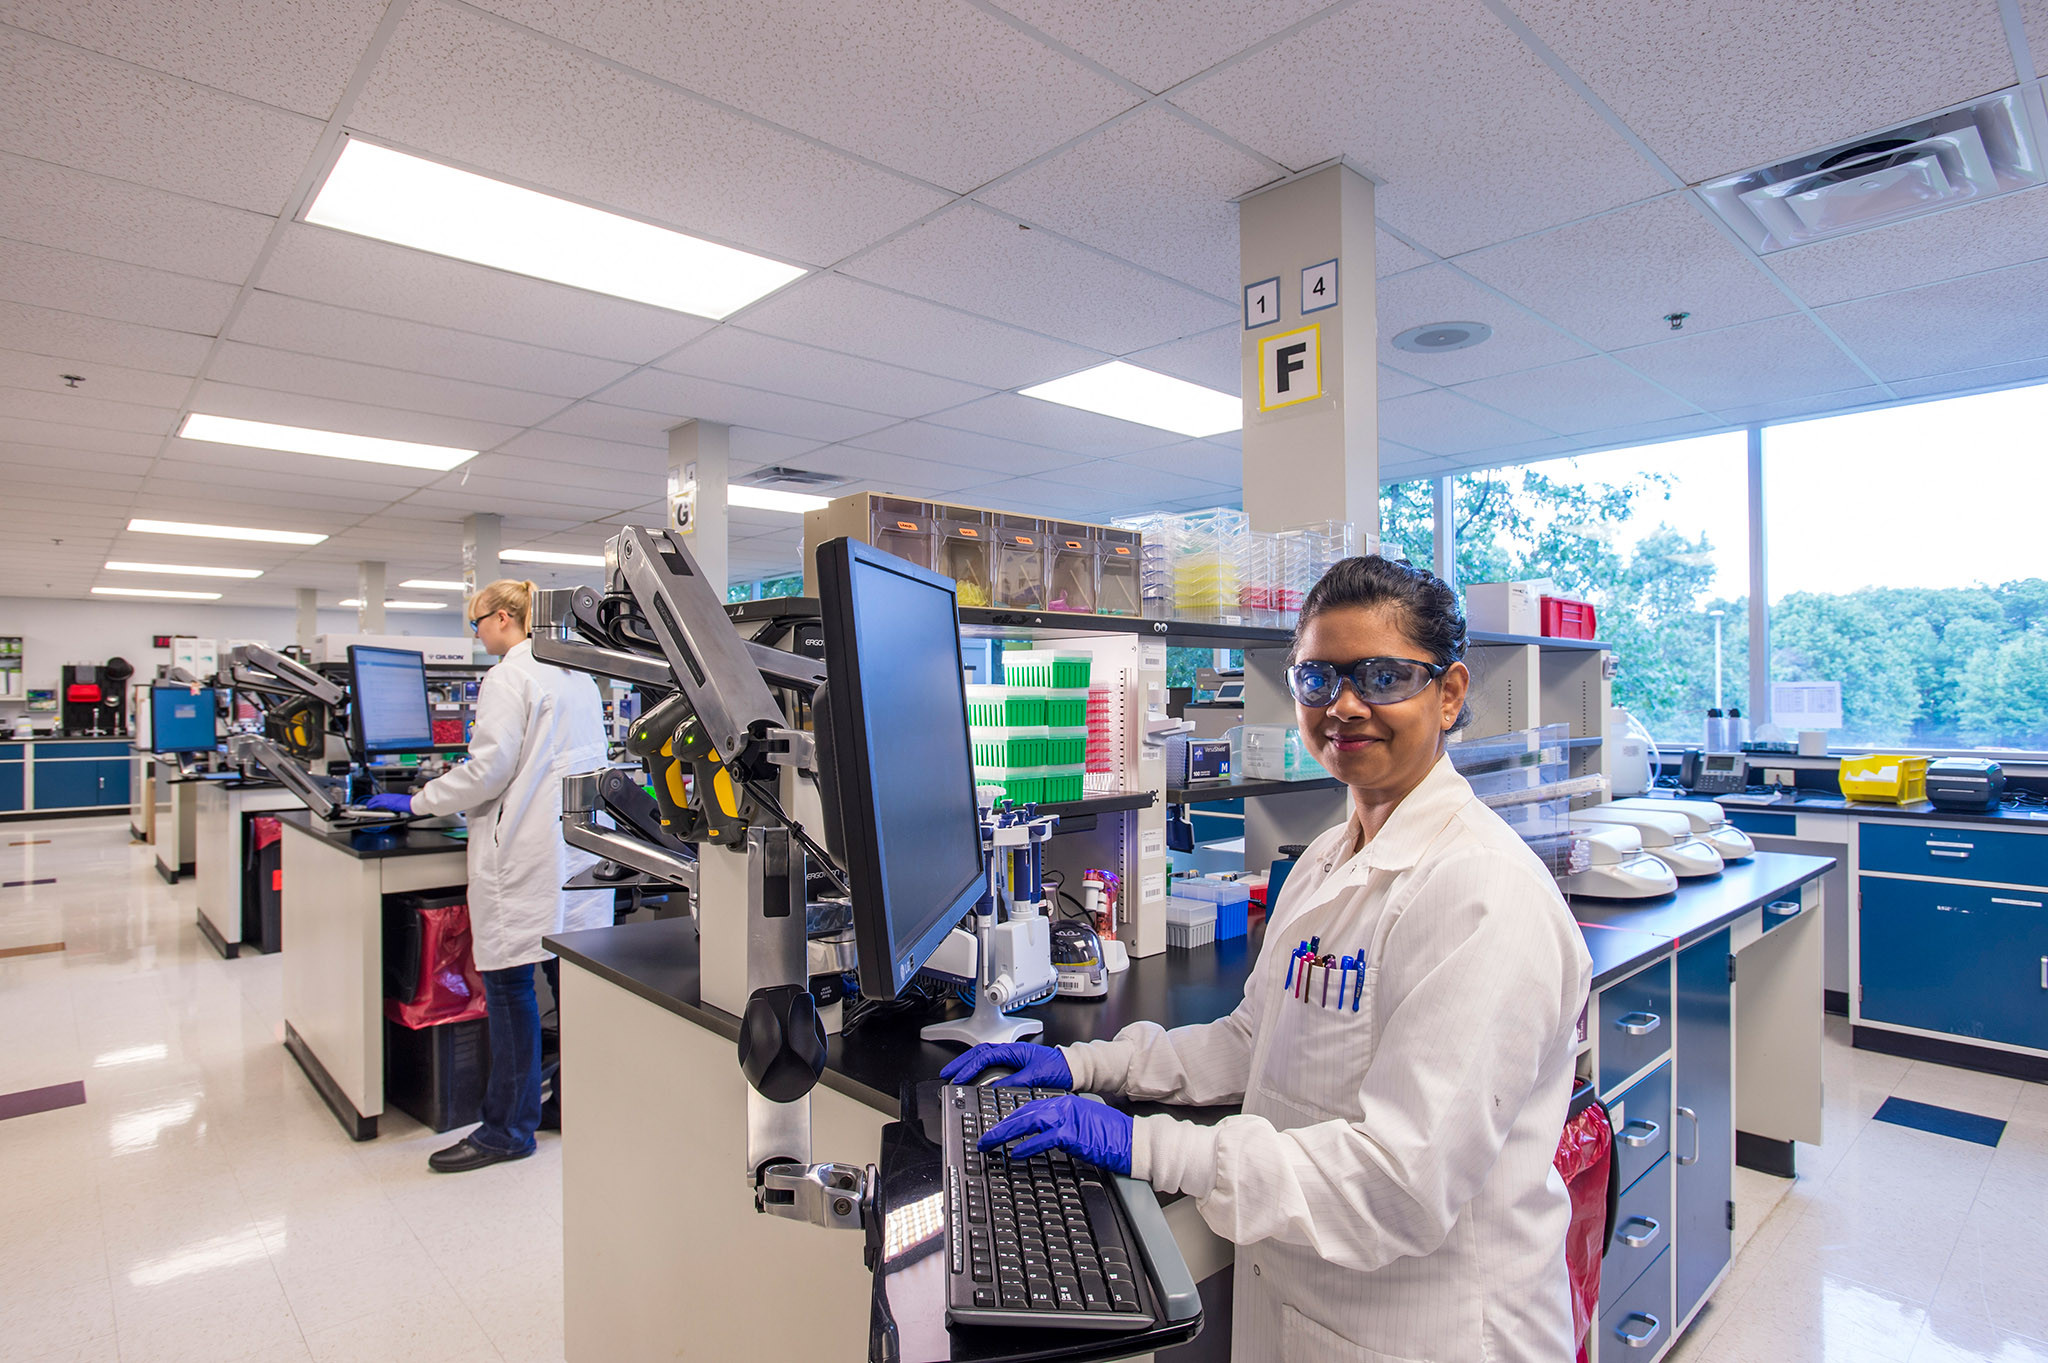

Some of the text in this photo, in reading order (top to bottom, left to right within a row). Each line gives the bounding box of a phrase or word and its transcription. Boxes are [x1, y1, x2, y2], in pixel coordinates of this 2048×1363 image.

[1312, 276, 1326, 296] 4
[1256, 296, 1265, 314] 1
[1276, 342, 1306, 393] F
[677, 502, 689, 526] G
[1221, 762, 1228, 772] M
